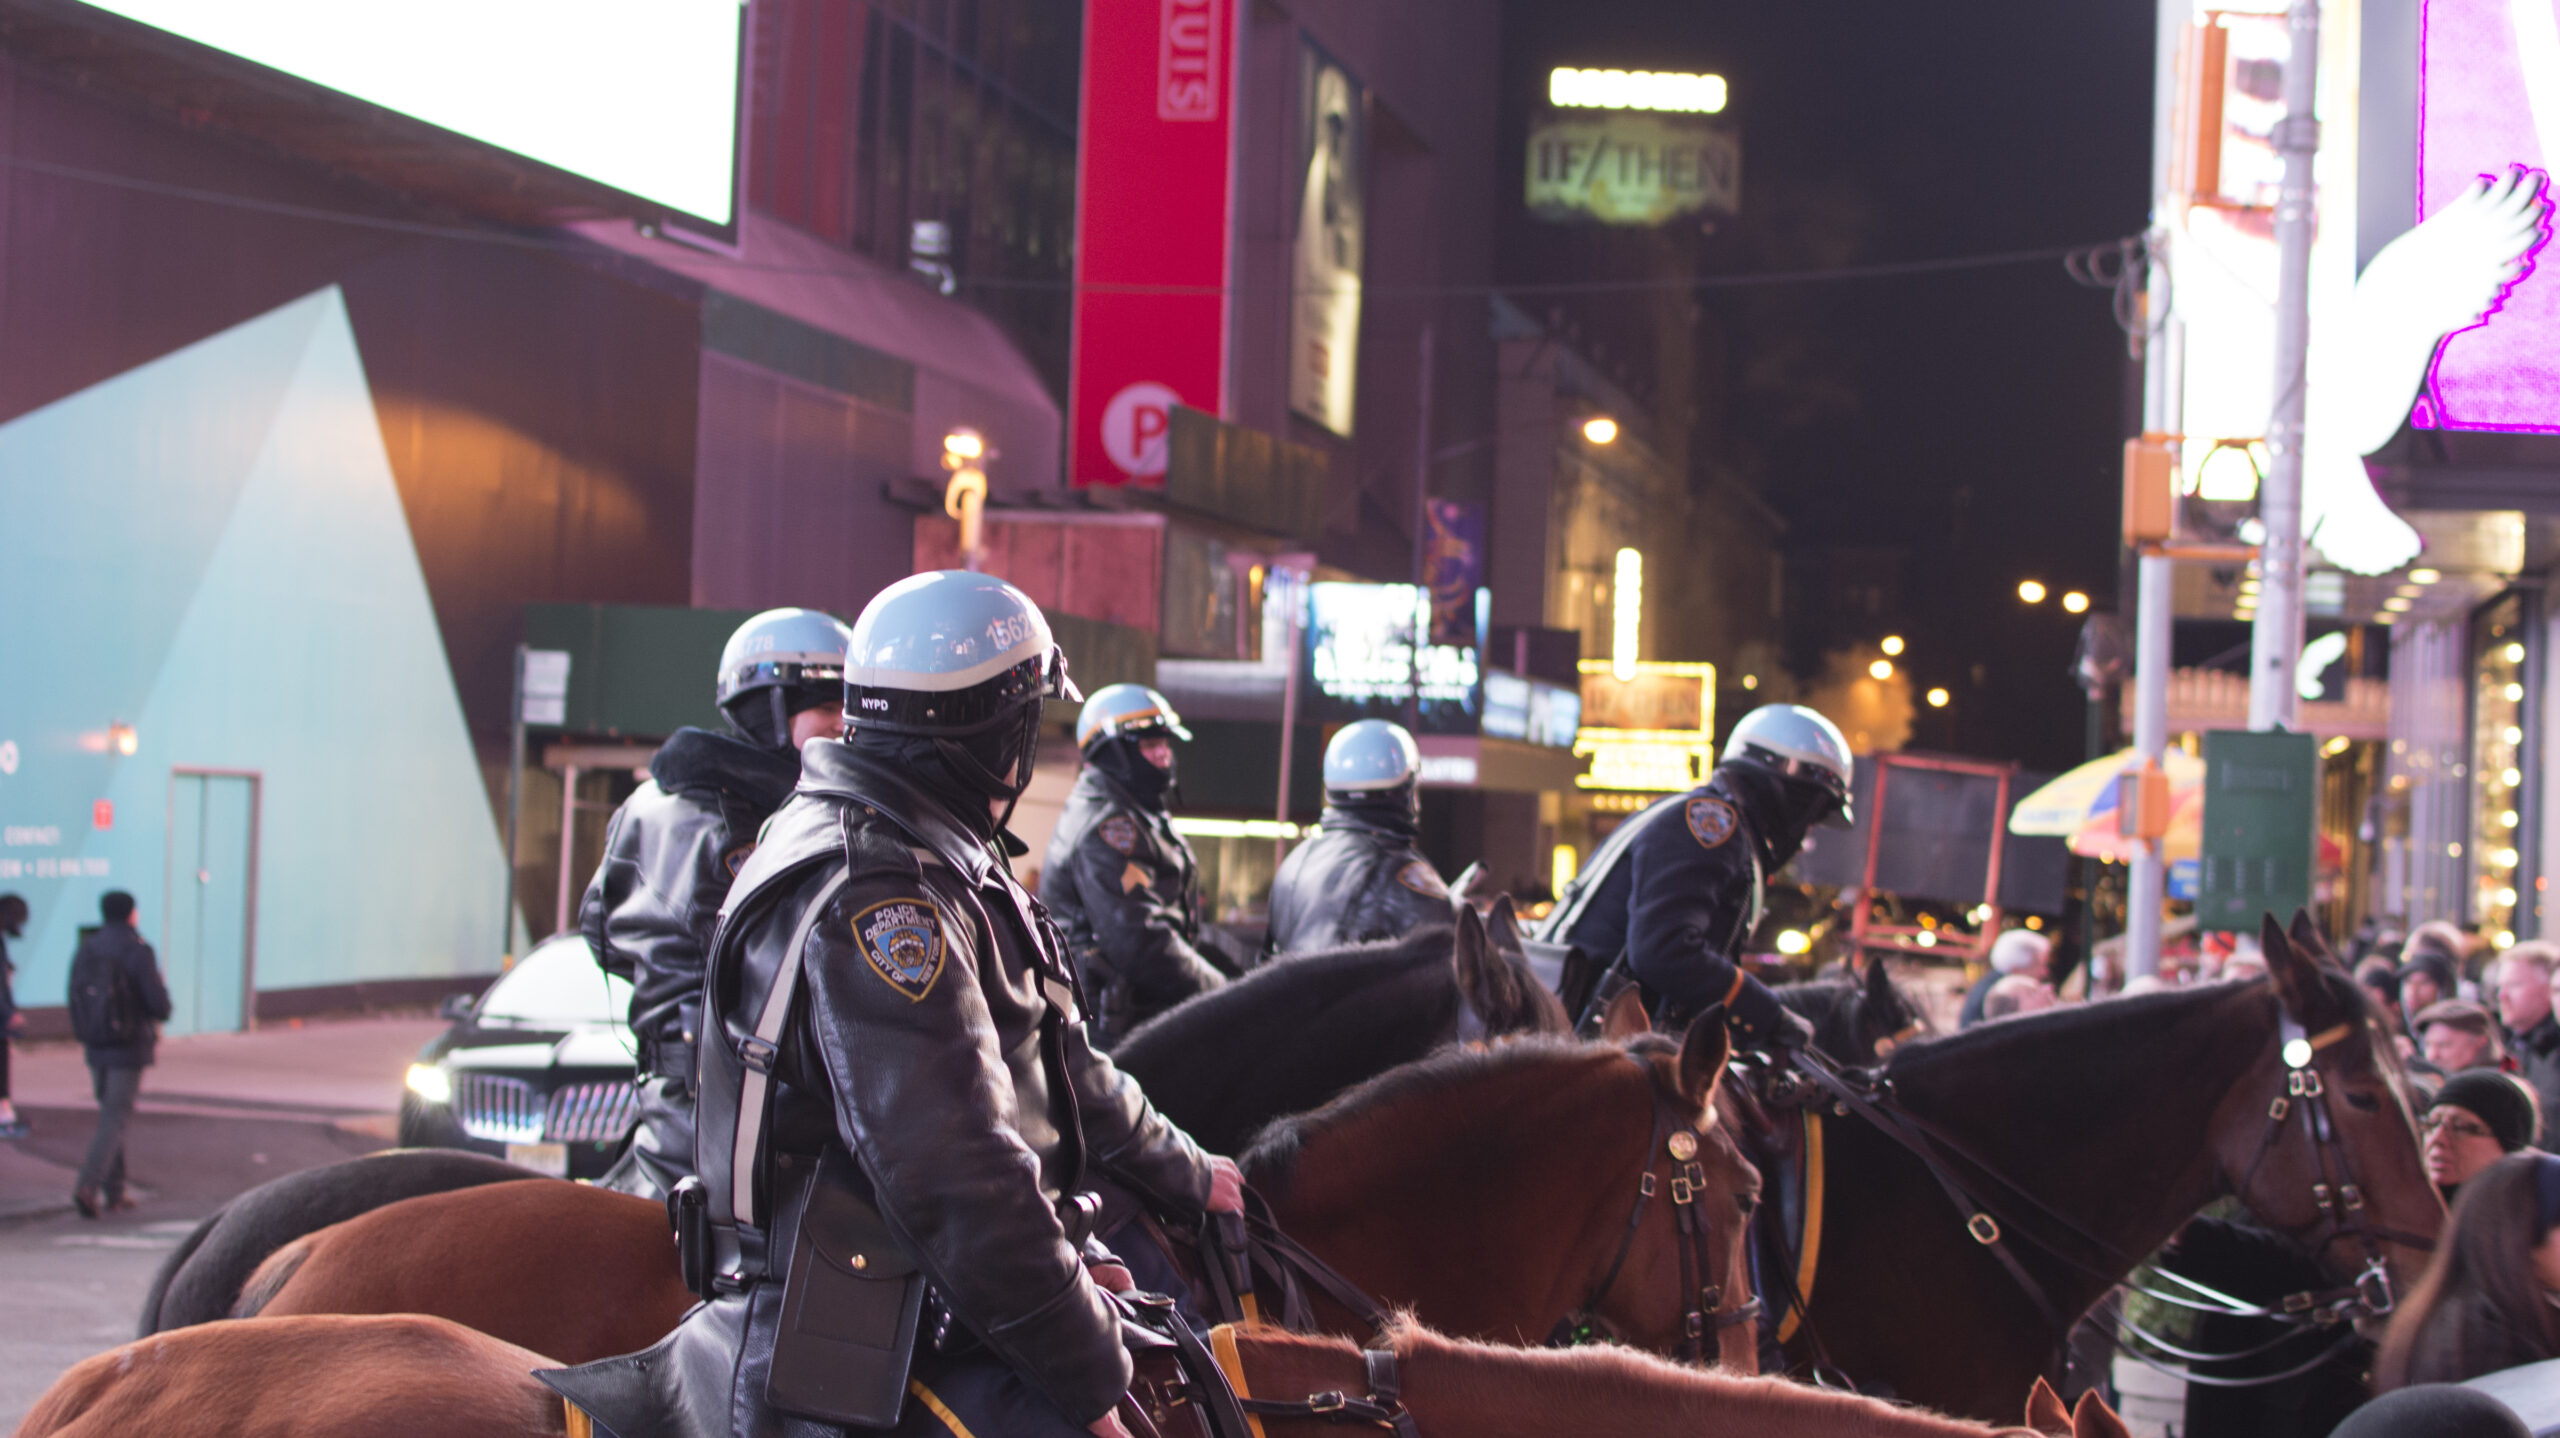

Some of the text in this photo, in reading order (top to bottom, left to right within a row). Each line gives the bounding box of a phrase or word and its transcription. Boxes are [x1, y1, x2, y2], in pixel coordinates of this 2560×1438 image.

[1169, 0, 1206, 108] UIS
[1540, 136, 1728, 192] IF/THEN
[985, 613, 1037, 650] 1562
[861, 697, 889, 711] NYPD
[865, 913, 935, 942] DEPARTMENT
[874, 904, 917, 922] POLICE
[871, 949, 893, 972] CITY
[891, 971, 907, 984] OF
